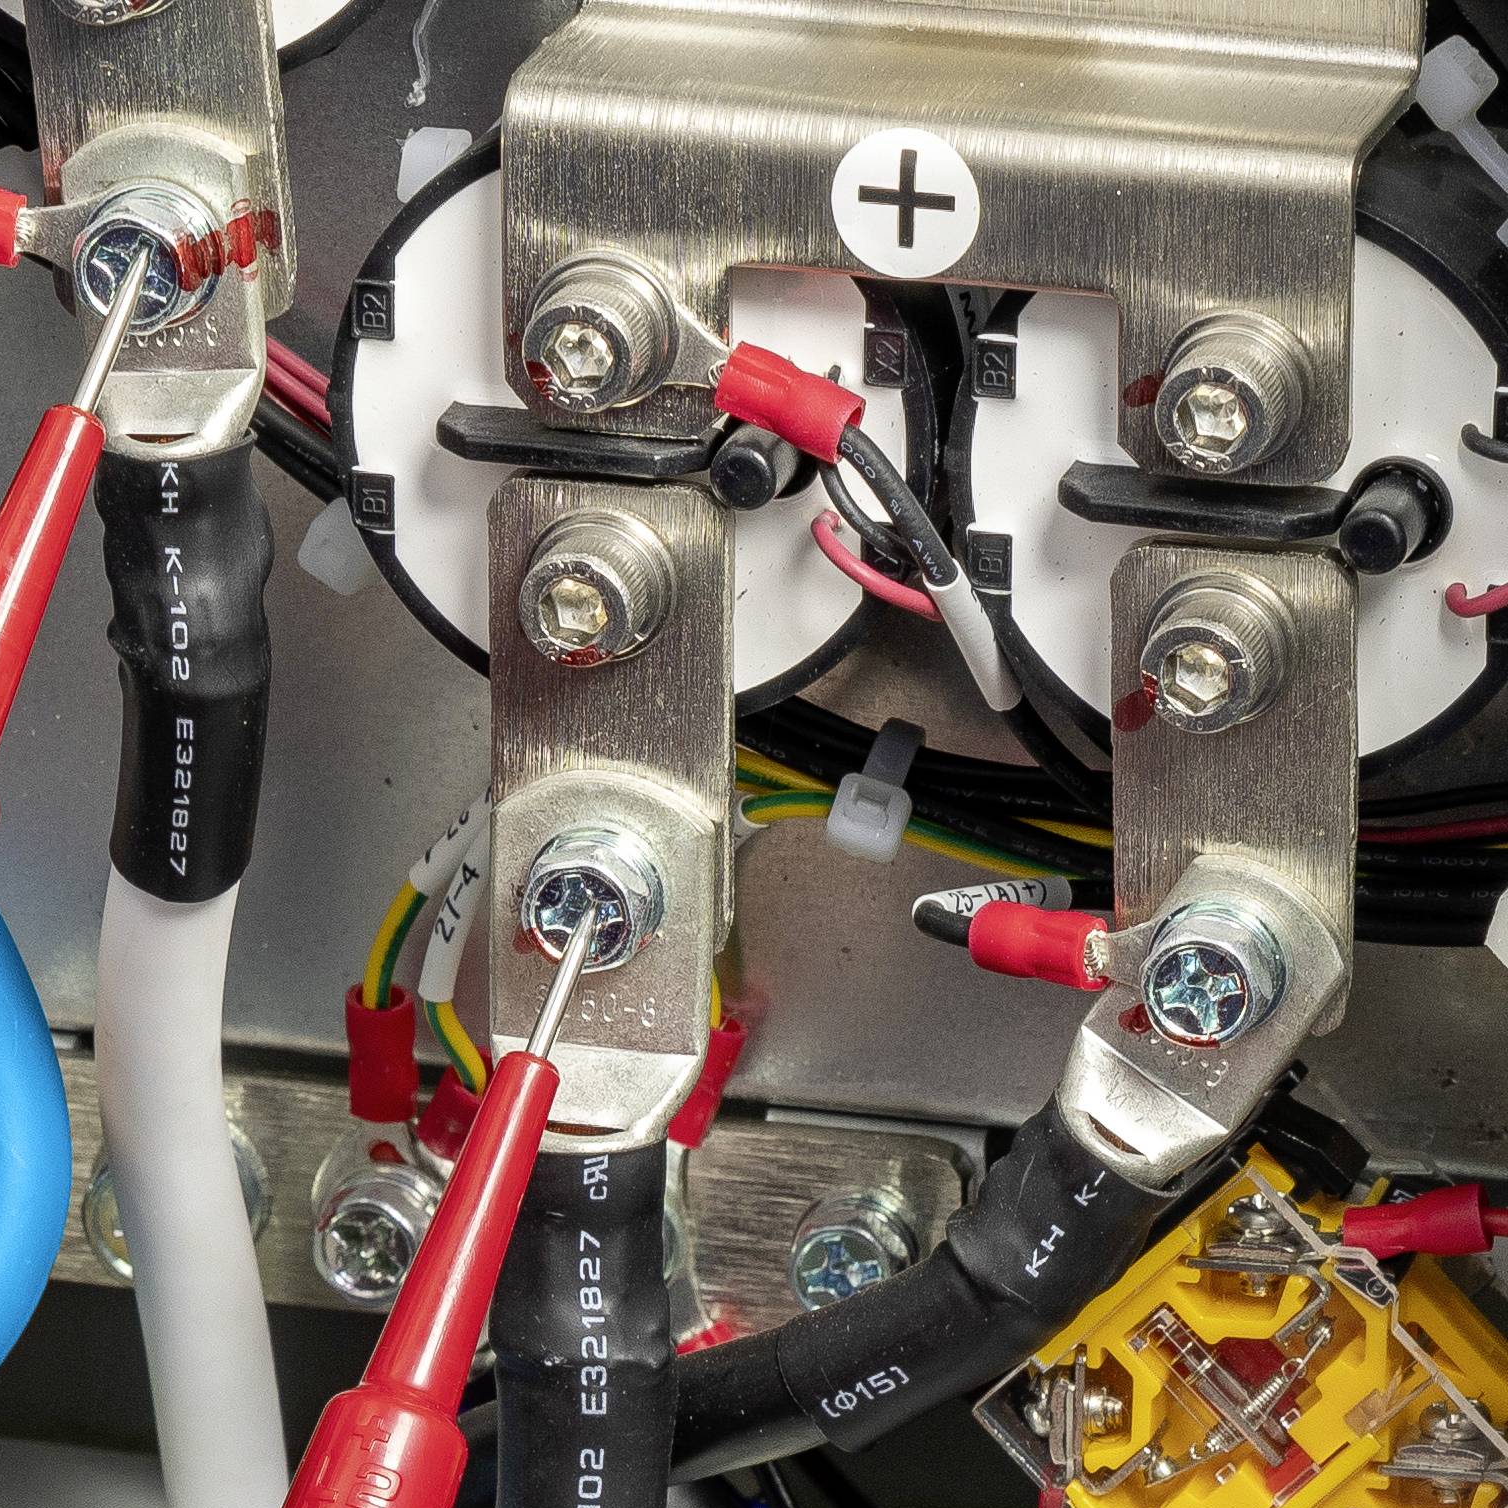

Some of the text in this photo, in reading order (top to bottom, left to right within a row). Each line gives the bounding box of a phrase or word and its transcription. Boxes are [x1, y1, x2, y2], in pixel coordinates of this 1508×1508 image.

[362, 292, 388, 329] B2
[982, 351, 1008, 388] B2
[362, 487, 387, 515] B1
[978, 547, 1003, 574] B1
[160, 461, 195, 877] KH K-102 E321827
[434, 862, 480, 944] 27-4
[1024, 1224, 1065, 1278] KH
[579, 1229, 608, 1416] E321827
